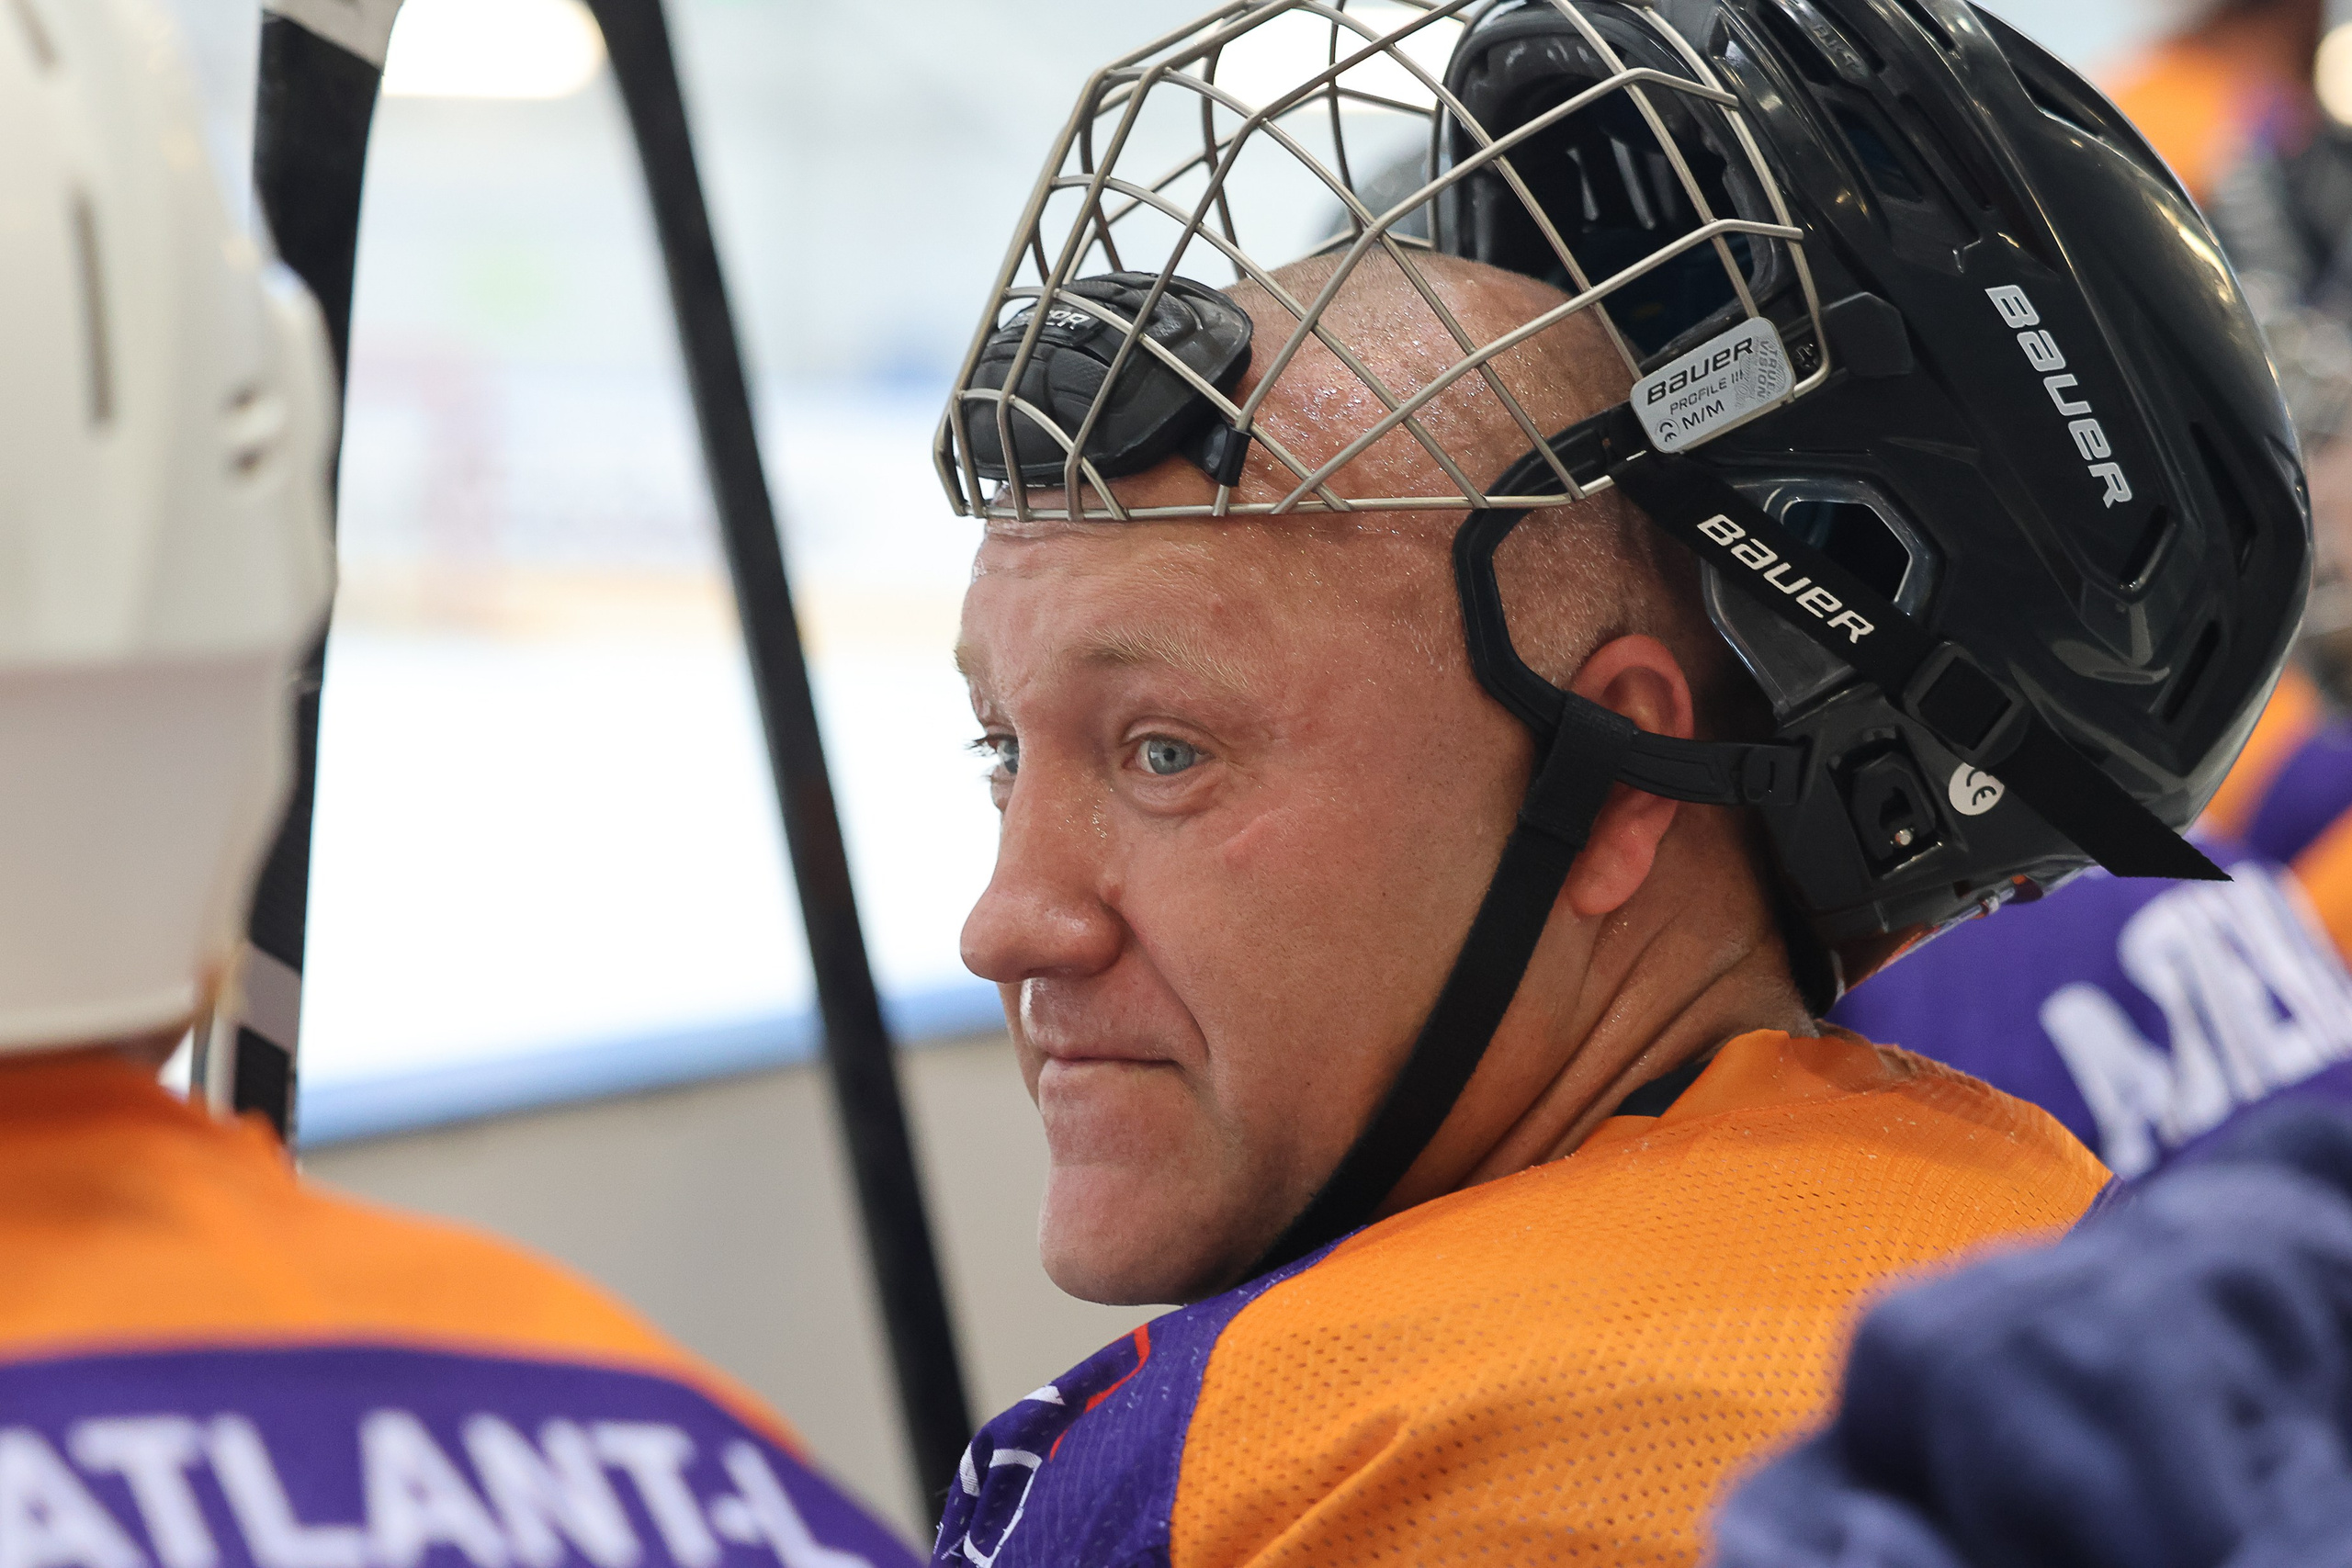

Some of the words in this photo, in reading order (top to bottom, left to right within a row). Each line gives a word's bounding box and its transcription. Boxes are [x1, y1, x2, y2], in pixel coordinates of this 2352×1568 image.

[1647, 337, 1753, 405] BAUER
[1670, 378, 1727, 415] PROFILE
[1757, 341, 1770, 399] VISION
[1984, 284, 2132, 509] BAUER
[1682, 400, 1724, 430] M/M
[1697, 513, 1874, 644] BAUER
